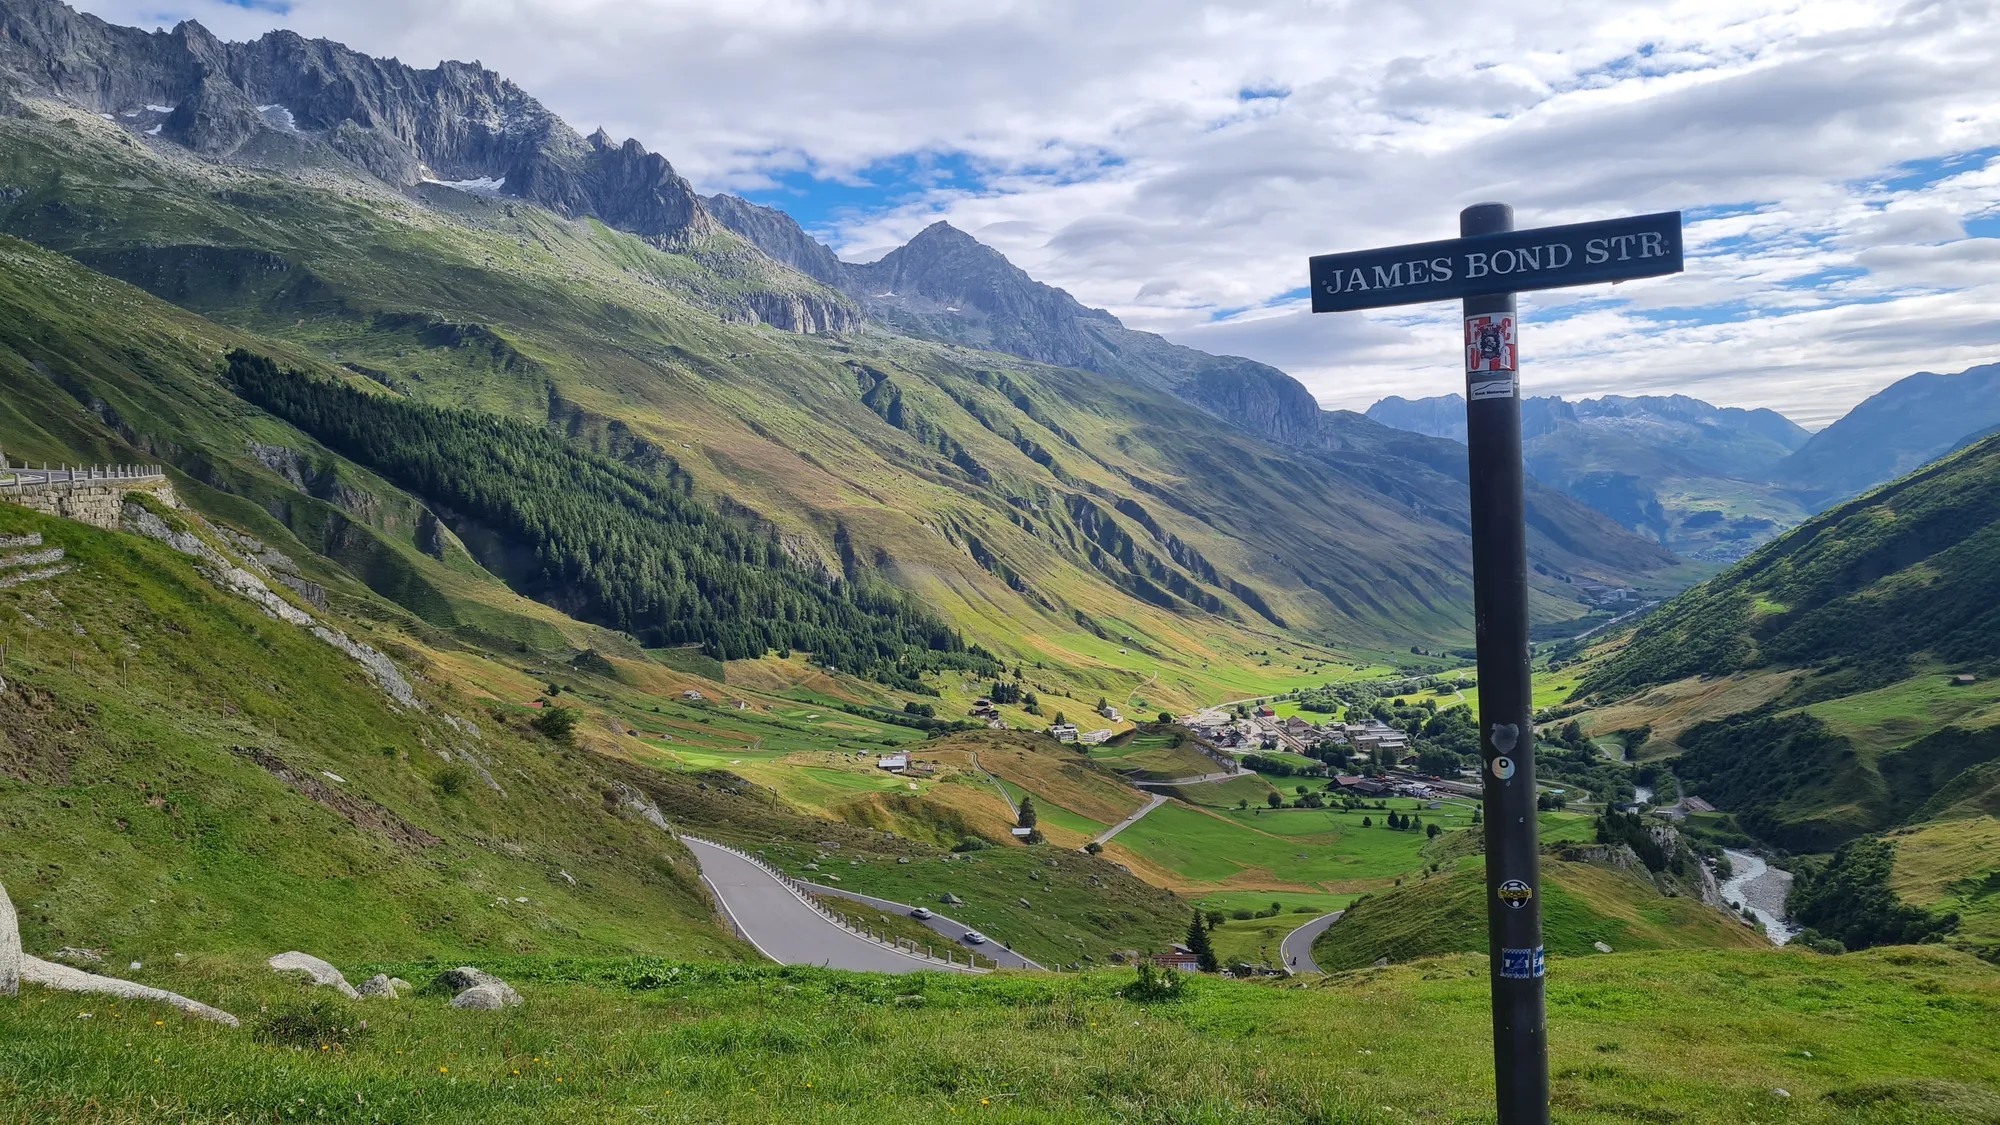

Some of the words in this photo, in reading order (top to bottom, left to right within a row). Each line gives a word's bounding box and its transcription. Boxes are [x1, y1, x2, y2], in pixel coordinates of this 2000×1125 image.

[1326, 256, 1453, 294] JAMES
[1464, 243, 1573, 279] BOND
[1585, 231, 1670, 264] STR.
